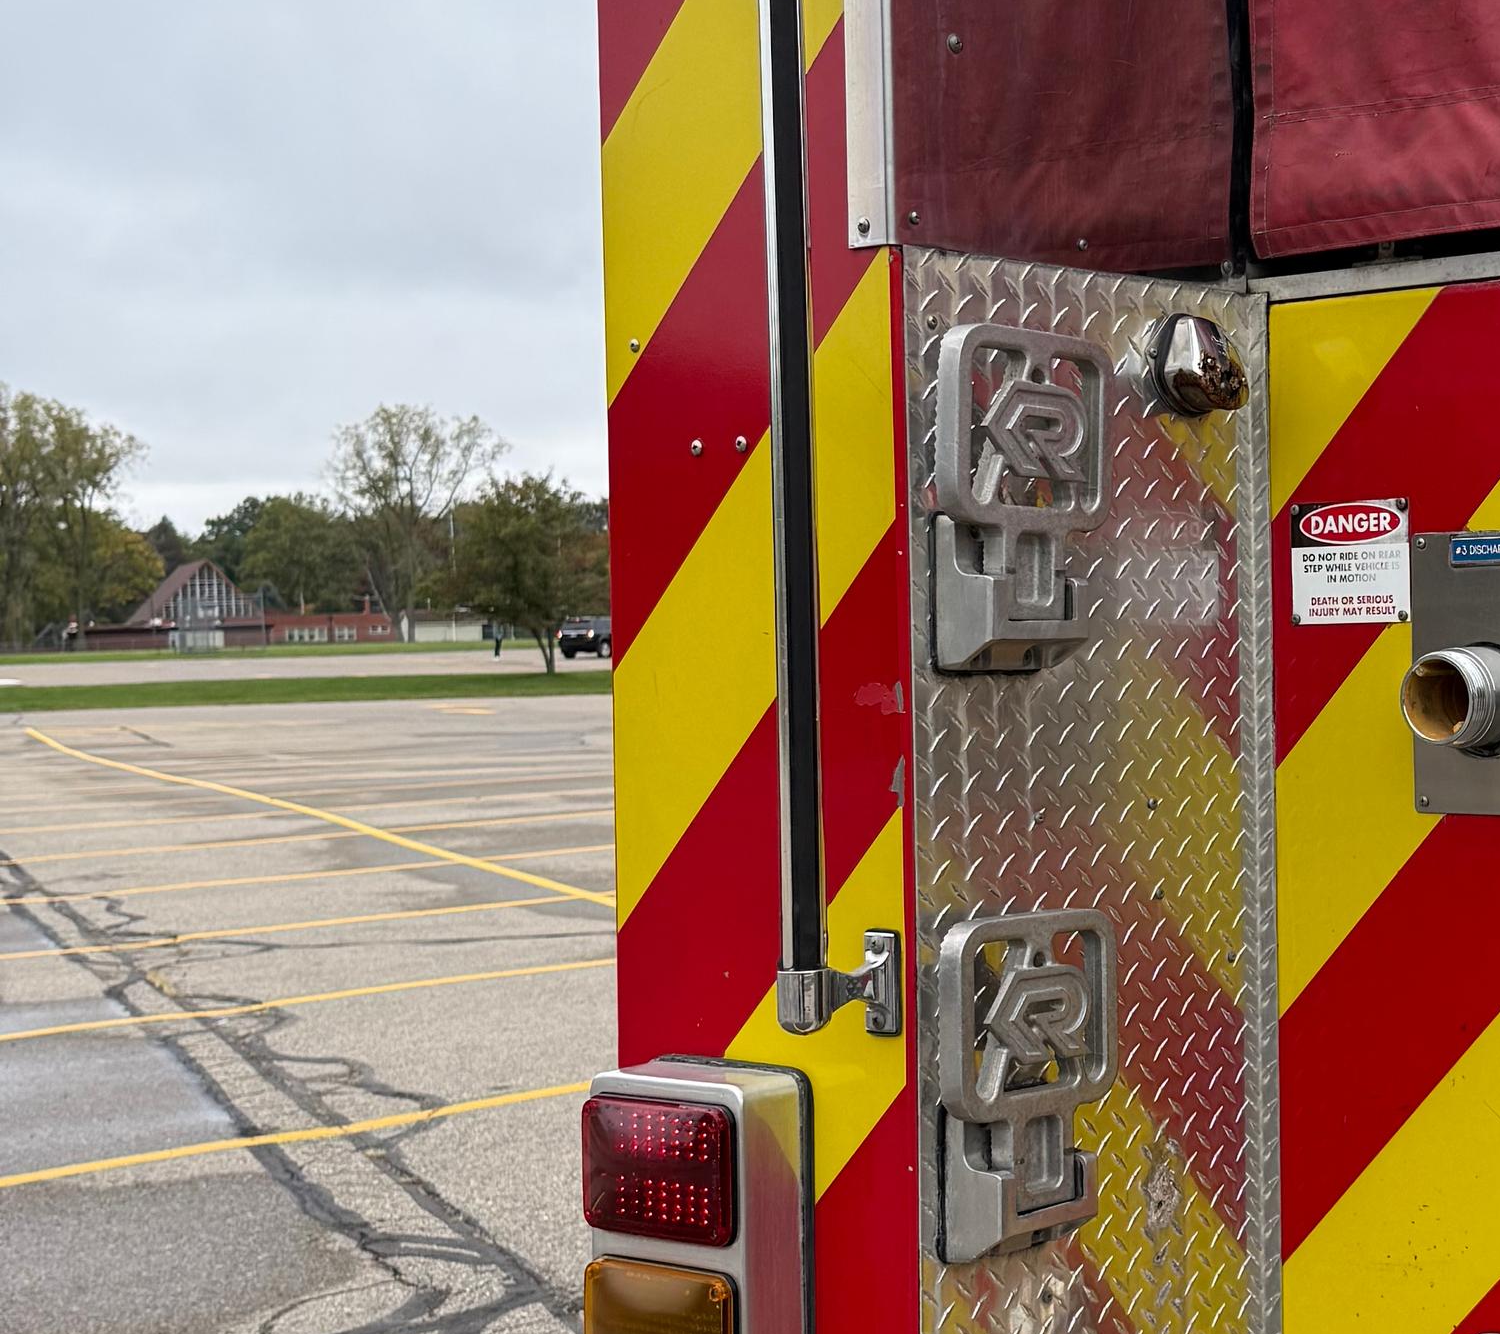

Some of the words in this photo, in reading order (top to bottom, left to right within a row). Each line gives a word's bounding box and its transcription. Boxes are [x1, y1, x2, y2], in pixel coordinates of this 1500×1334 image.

[1310, 512, 1393, 535] DANGER
[1455, 544, 1468, 555] #3
[1302, 554, 1316, 562] DO
[1318, 553, 1337, 562] NOT
[1339, 552, 1358, 561] RIDE
[1361, 551, 1376, 560] ON
[1378, 550, 1401, 559] REAR
[1304, 564, 1323, 573] STEP
[1325, 563, 1351, 572] WHILE
[1354, 562, 1389, 571] VEHICLE
[1391, 561, 1400, 569] IS
[1327, 575, 1337, 583] IN
[1340, 574, 1377, 583] MOTION
[1311, 597, 1338, 605] DEATH
[1341, 596, 1354, 604] OR
[1357, 595, 1393, 604] SERIOUS
[1309, 608, 1340, 617] INJURY
[1342, 607, 1364, 616] MAY
[1366, 606, 1396, 615] RESULT
